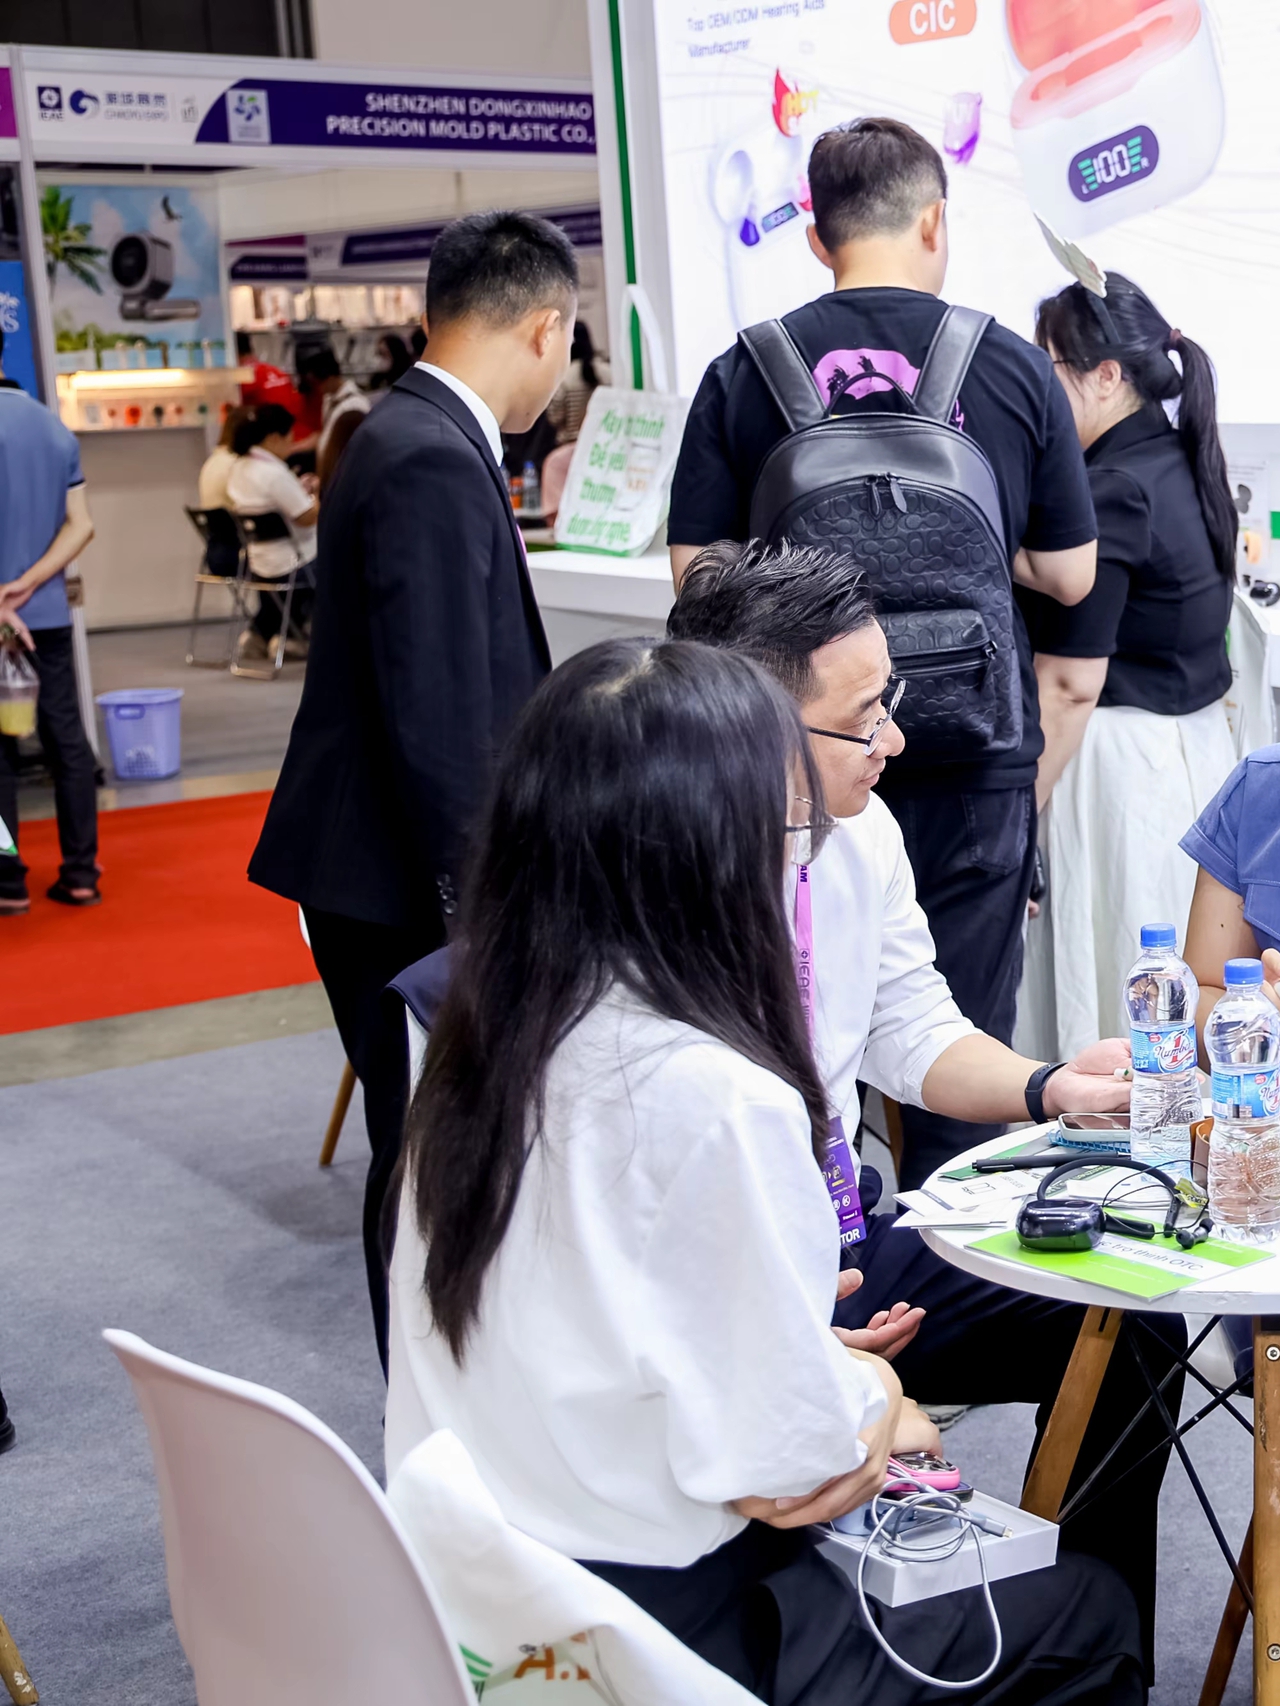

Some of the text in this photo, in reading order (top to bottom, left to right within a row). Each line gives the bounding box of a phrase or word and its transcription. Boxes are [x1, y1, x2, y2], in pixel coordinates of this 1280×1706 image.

[909, 0, 956, 36] CIC
[365, 92, 466, 115] SHENZHEN
[326, 114, 426, 137] PRECISION
[429, 118, 485, 140] MOLD
[487, 121, 560, 142] PLASTIC
[1093, 144, 1132, 183] 100
